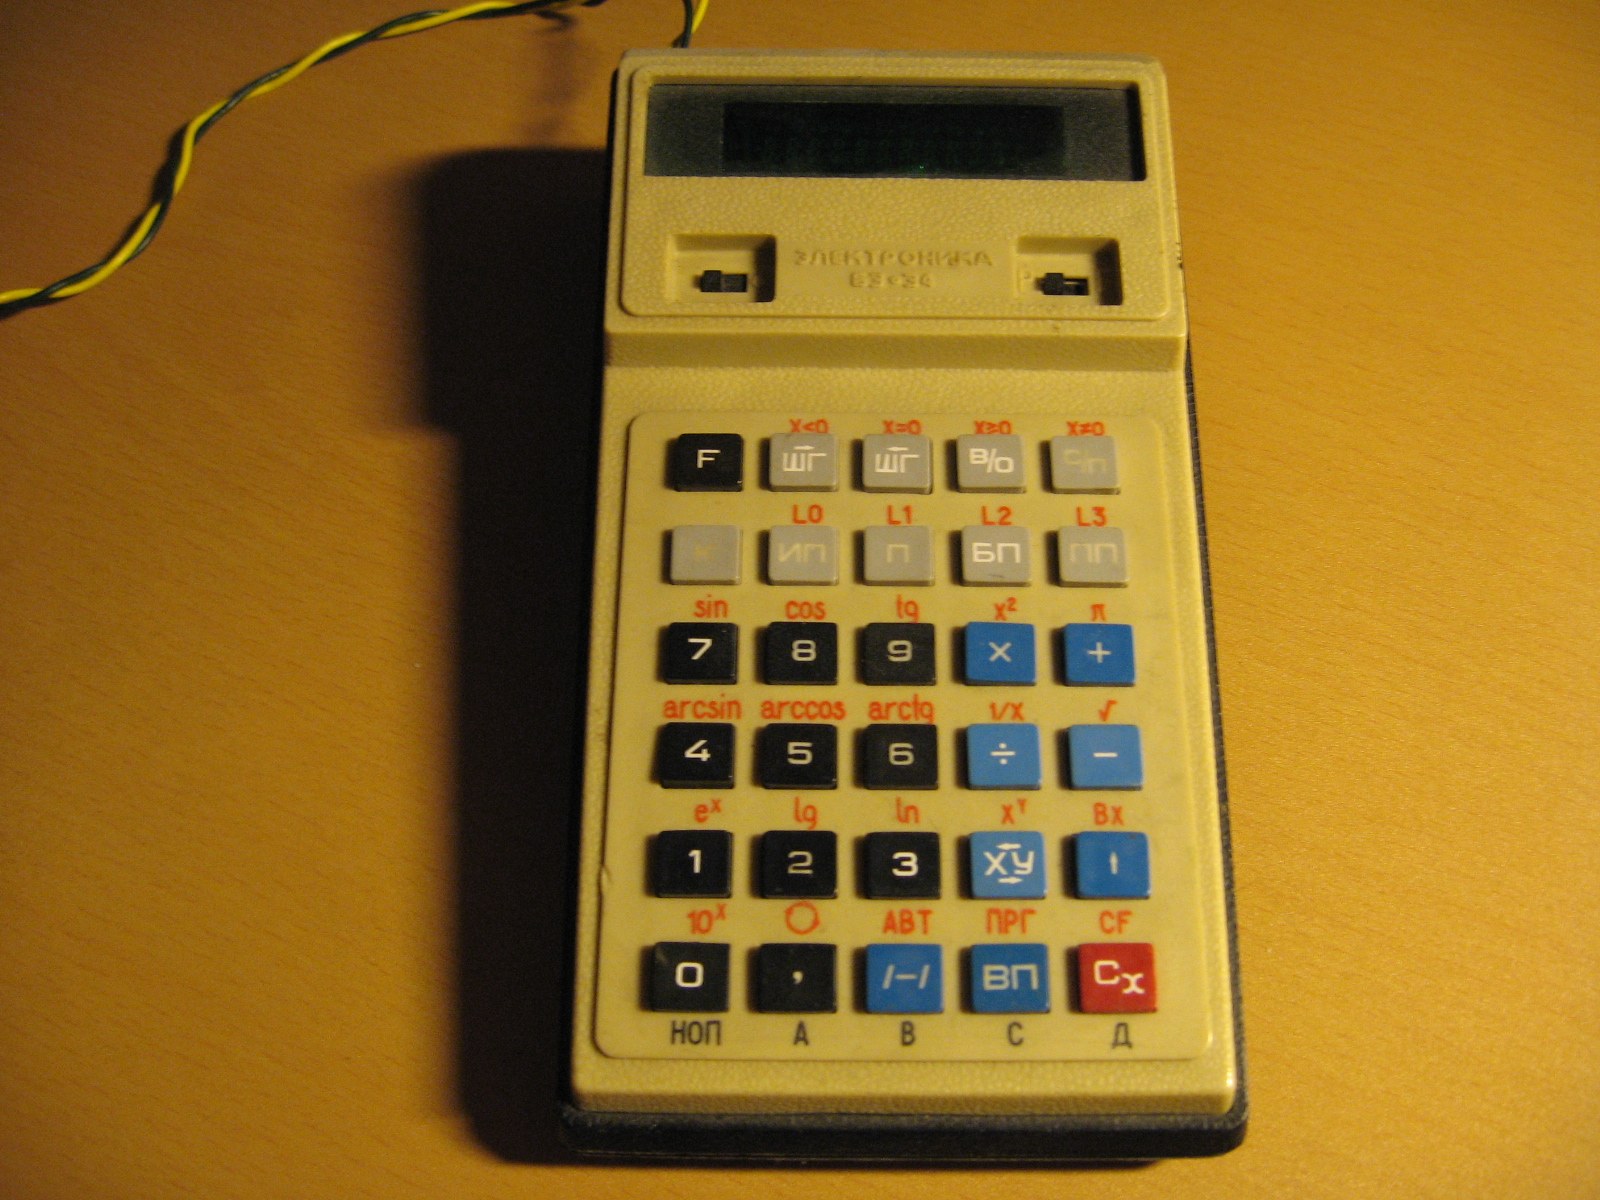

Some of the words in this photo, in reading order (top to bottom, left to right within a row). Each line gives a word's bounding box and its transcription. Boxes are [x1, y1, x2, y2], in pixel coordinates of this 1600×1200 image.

[697, 449, 721, 469] F
[792, 503, 825, 526] L0
[886, 504, 913, 526] L1
[981, 505, 1013, 527] L2
[1076, 505, 1108, 528] L3
[971, 542, 1021, 564] БП
[693, 594, 729, 619] sin
[785, 599, 828, 622] cos
[687, 637, 713, 660] 7
[791, 639, 817, 662] 8
[887, 639, 913, 662] 9
[662, 694, 743, 720] arcsin
[760, 699, 849, 721] arccos
[684, 739, 711, 762] 4
[787, 741, 813, 765] 5
[888, 742, 915, 766] 6
[895, 799, 921, 824] ln
[688, 849, 702, 874] 1
[787, 850, 813, 875] 2
[892, 851, 919, 877] 3
[986, 907, 1037, 935] ПРГ
[675, 961, 704, 988] 0
[982, 963, 1039, 991] ВП
[670, 1019, 722, 1046] НОП
